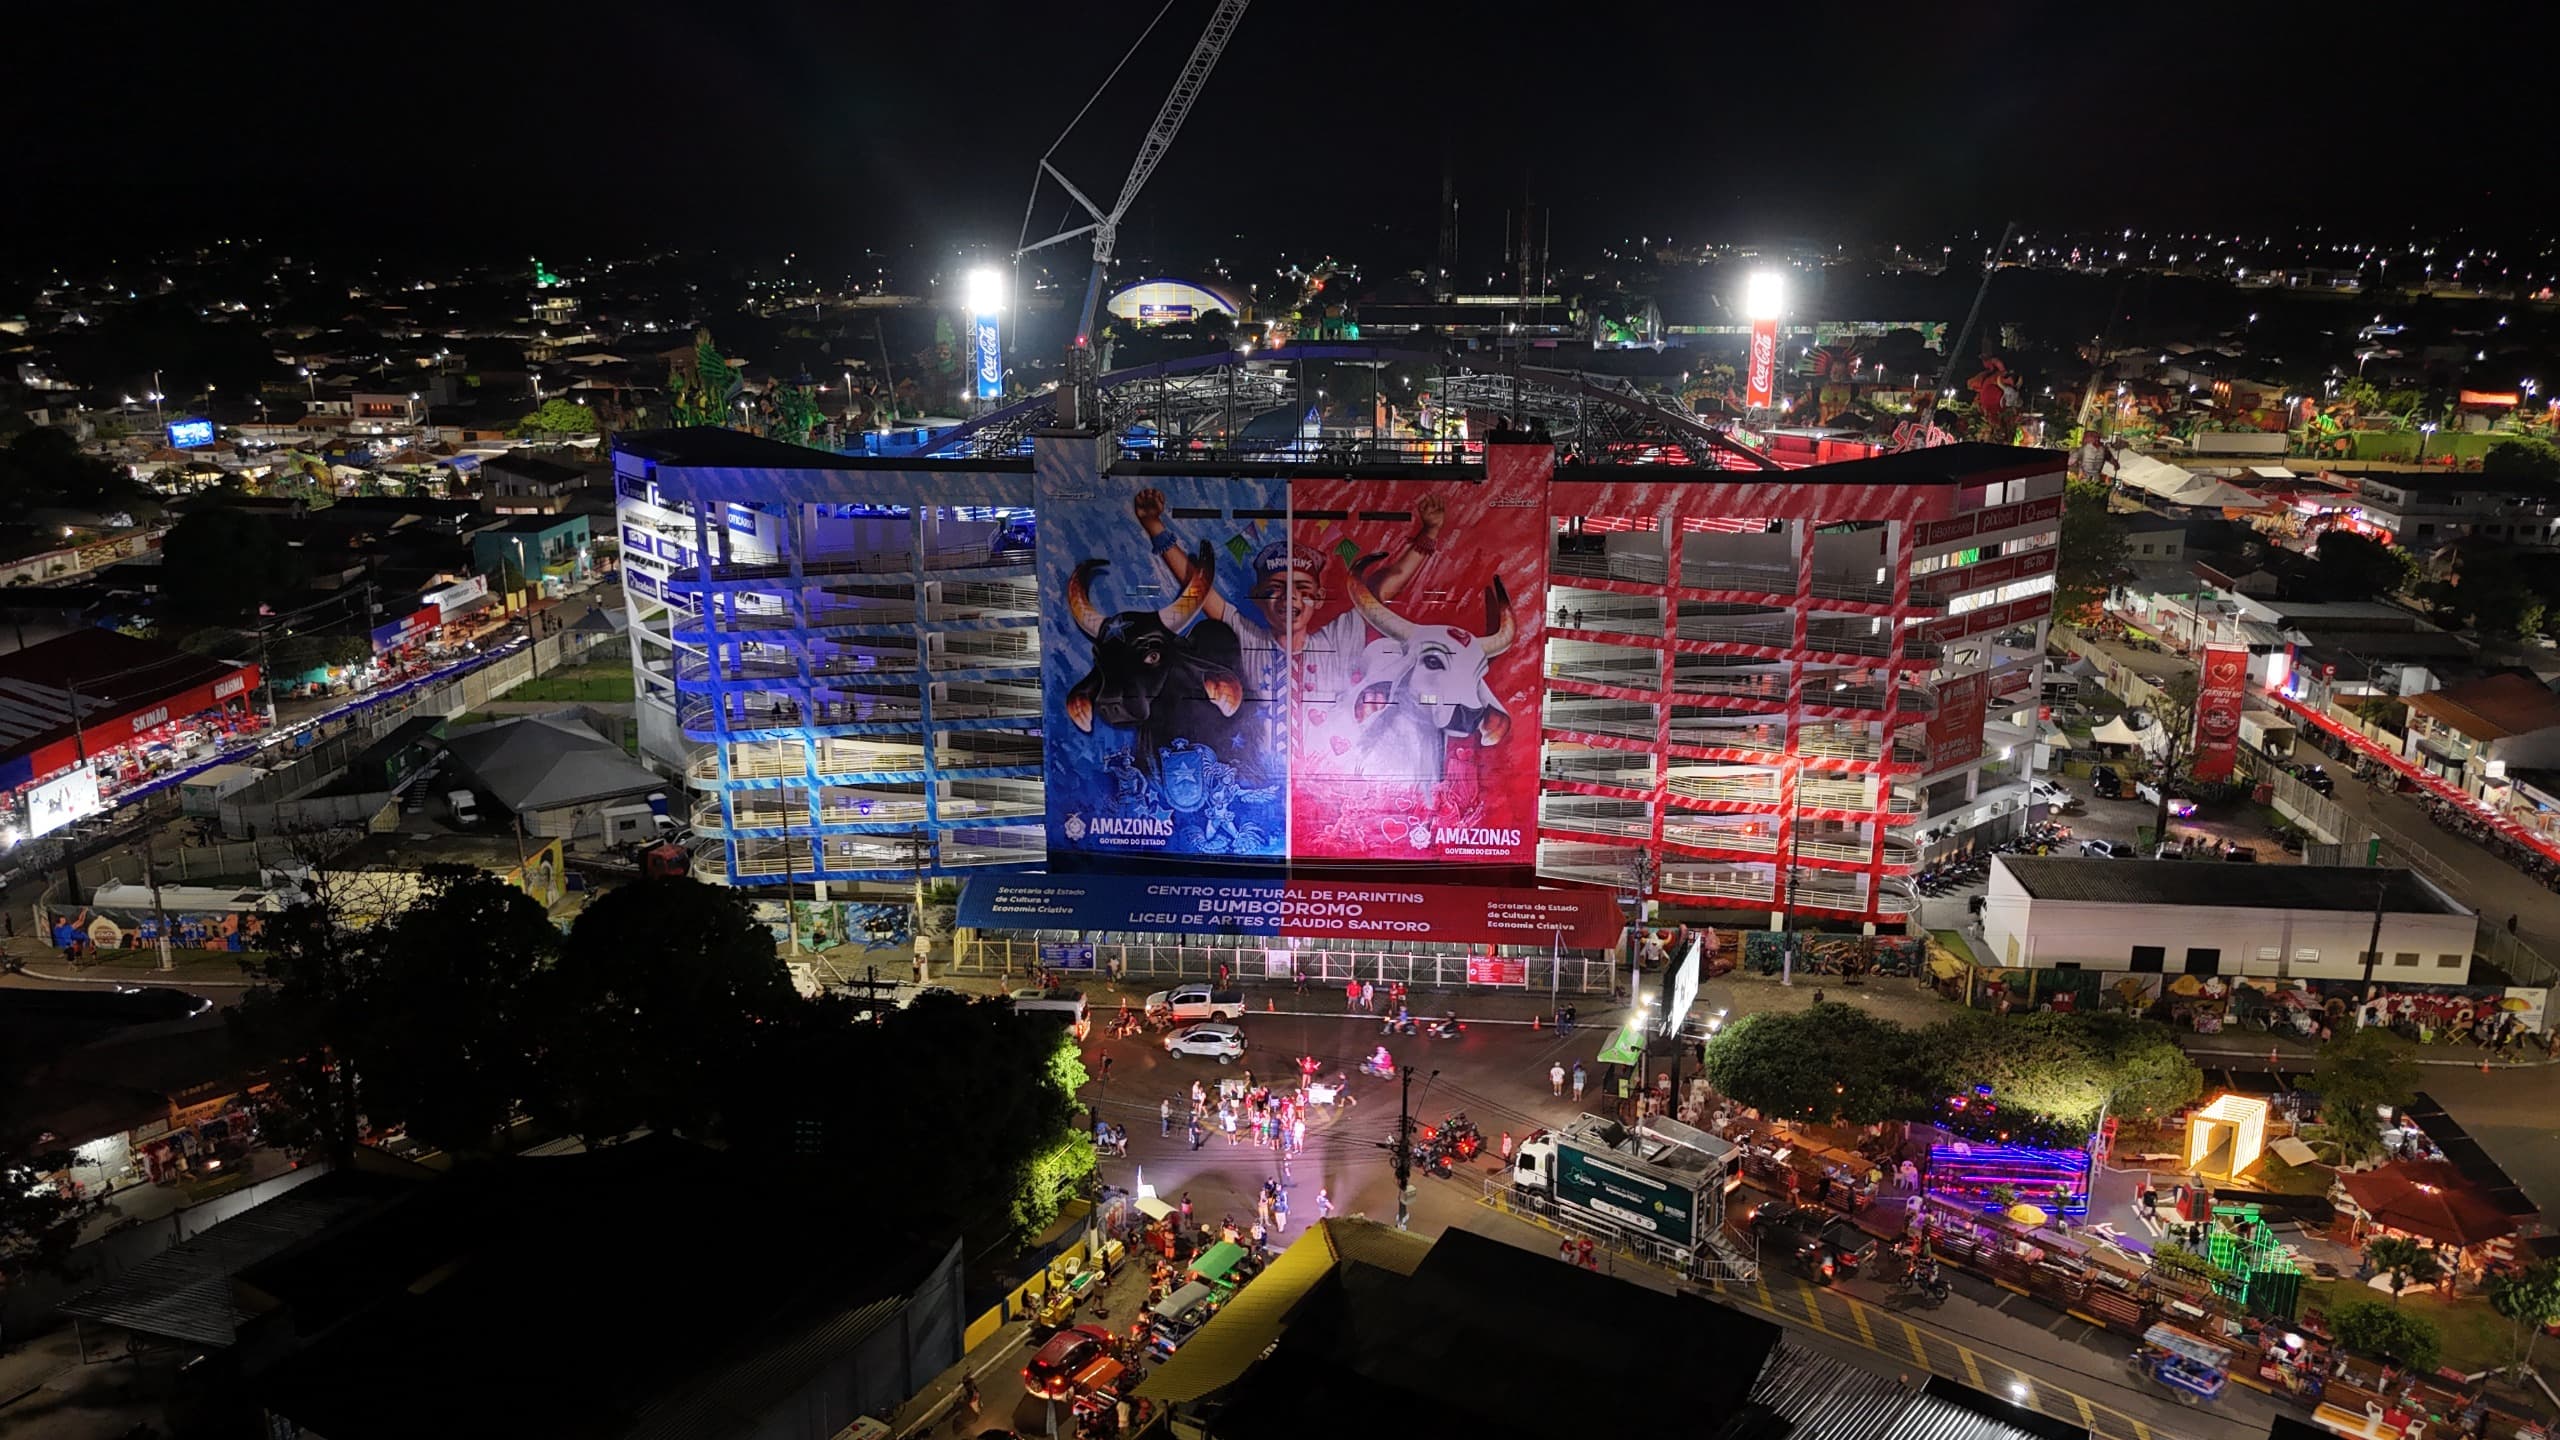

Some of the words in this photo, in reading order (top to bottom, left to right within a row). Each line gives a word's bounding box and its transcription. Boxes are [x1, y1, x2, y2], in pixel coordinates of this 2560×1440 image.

[978, 324, 998, 383] Coca-Cola
[1751, 330, 1772, 393] Coca-Cola
[214, 675, 245, 699] BRAHMA
[1090, 818, 1174, 836] AMAZONAS
[1435, 827, 1521, 846] AMAZONAS
[1130, 838, 1140, 846] DO
[1141, 838, 1166, 846] ESTADO
[1445, 847, 1475, 855] GOVERNO
[1475, 848, 1484, 856] DO
[1484, 848, 1510, 856] ESTADO
[998, 886, 1042, 895] Secretaria
[1043, 887, 1055, 895] de
[1056, 888, 1086, 896] Estado
[1147, 885, 1215, 896] CENTRO
[1219, 887, 1307, 899] CULTURAL
[1311, 890, 1333, 900] DE
[1337, 891, 1424, 903] PARINTINS
[1009, 896, 1042, 904] Cultura
[992, 904, 1036, 913] Economia
[1037, 905, 1074, 914] Criativa
[1487, 902, 1532, 910] Secretaria
[1534, 903, 1546, 911] de
[1547, 904, 1579, 912] Estado
[1501, 911, 1536, 919] Cultura
[1128, 912, 1177, 923] LICEU
[1181, 914, 1204, 925] DE
[1208, 915, 1264, 926] ARTES
[1268, 917, 1344, 929] CLAUDIO
[1348, 919, 1431, 932] SANTORO
[1487, 921, 1534, 929] Economia
[1535, 922, 1575, 930] Criativa
